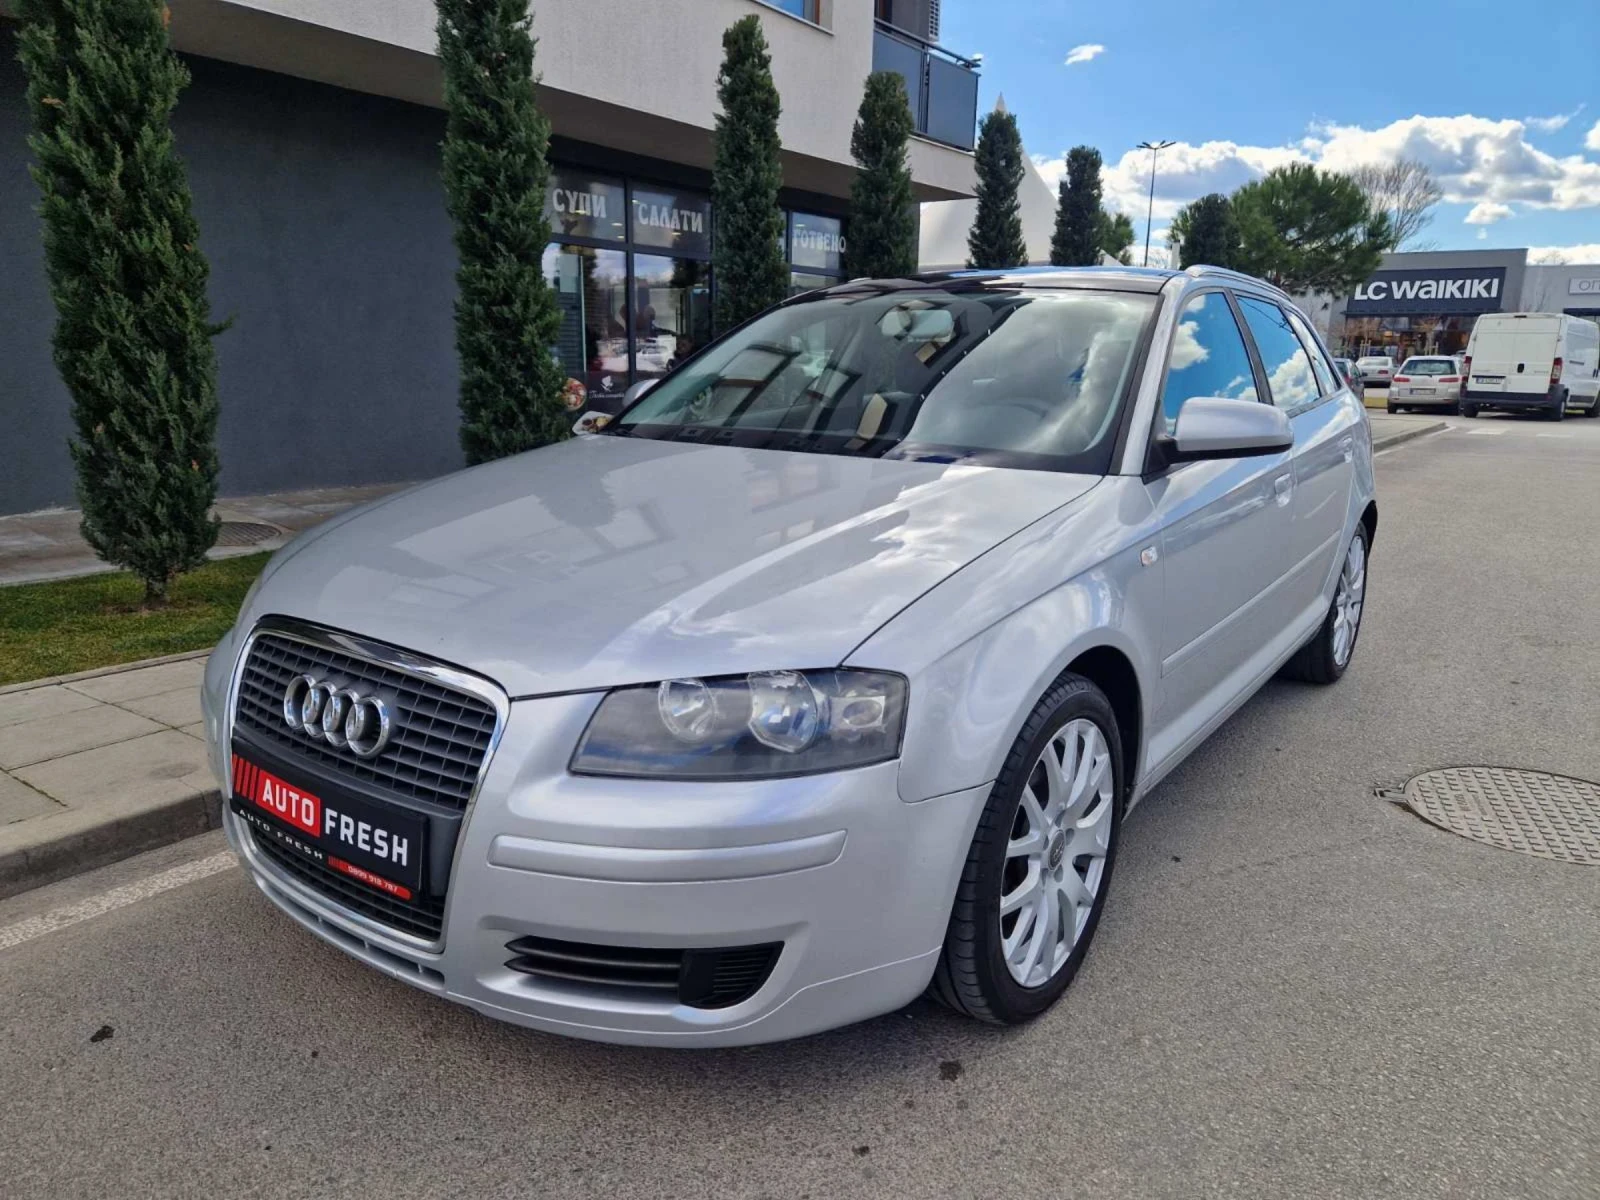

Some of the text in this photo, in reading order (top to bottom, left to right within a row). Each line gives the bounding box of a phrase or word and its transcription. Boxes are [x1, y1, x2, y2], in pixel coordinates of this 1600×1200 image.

[552, 188, 607, 219] СУПИ
[639, 203, 703, 233] САЛАТИ
[1354, 281, 1388, 300] LC
[239, 809, 323, 859] AUTO FRESH
[262, 779, 408, 866] AUTO FRESH
